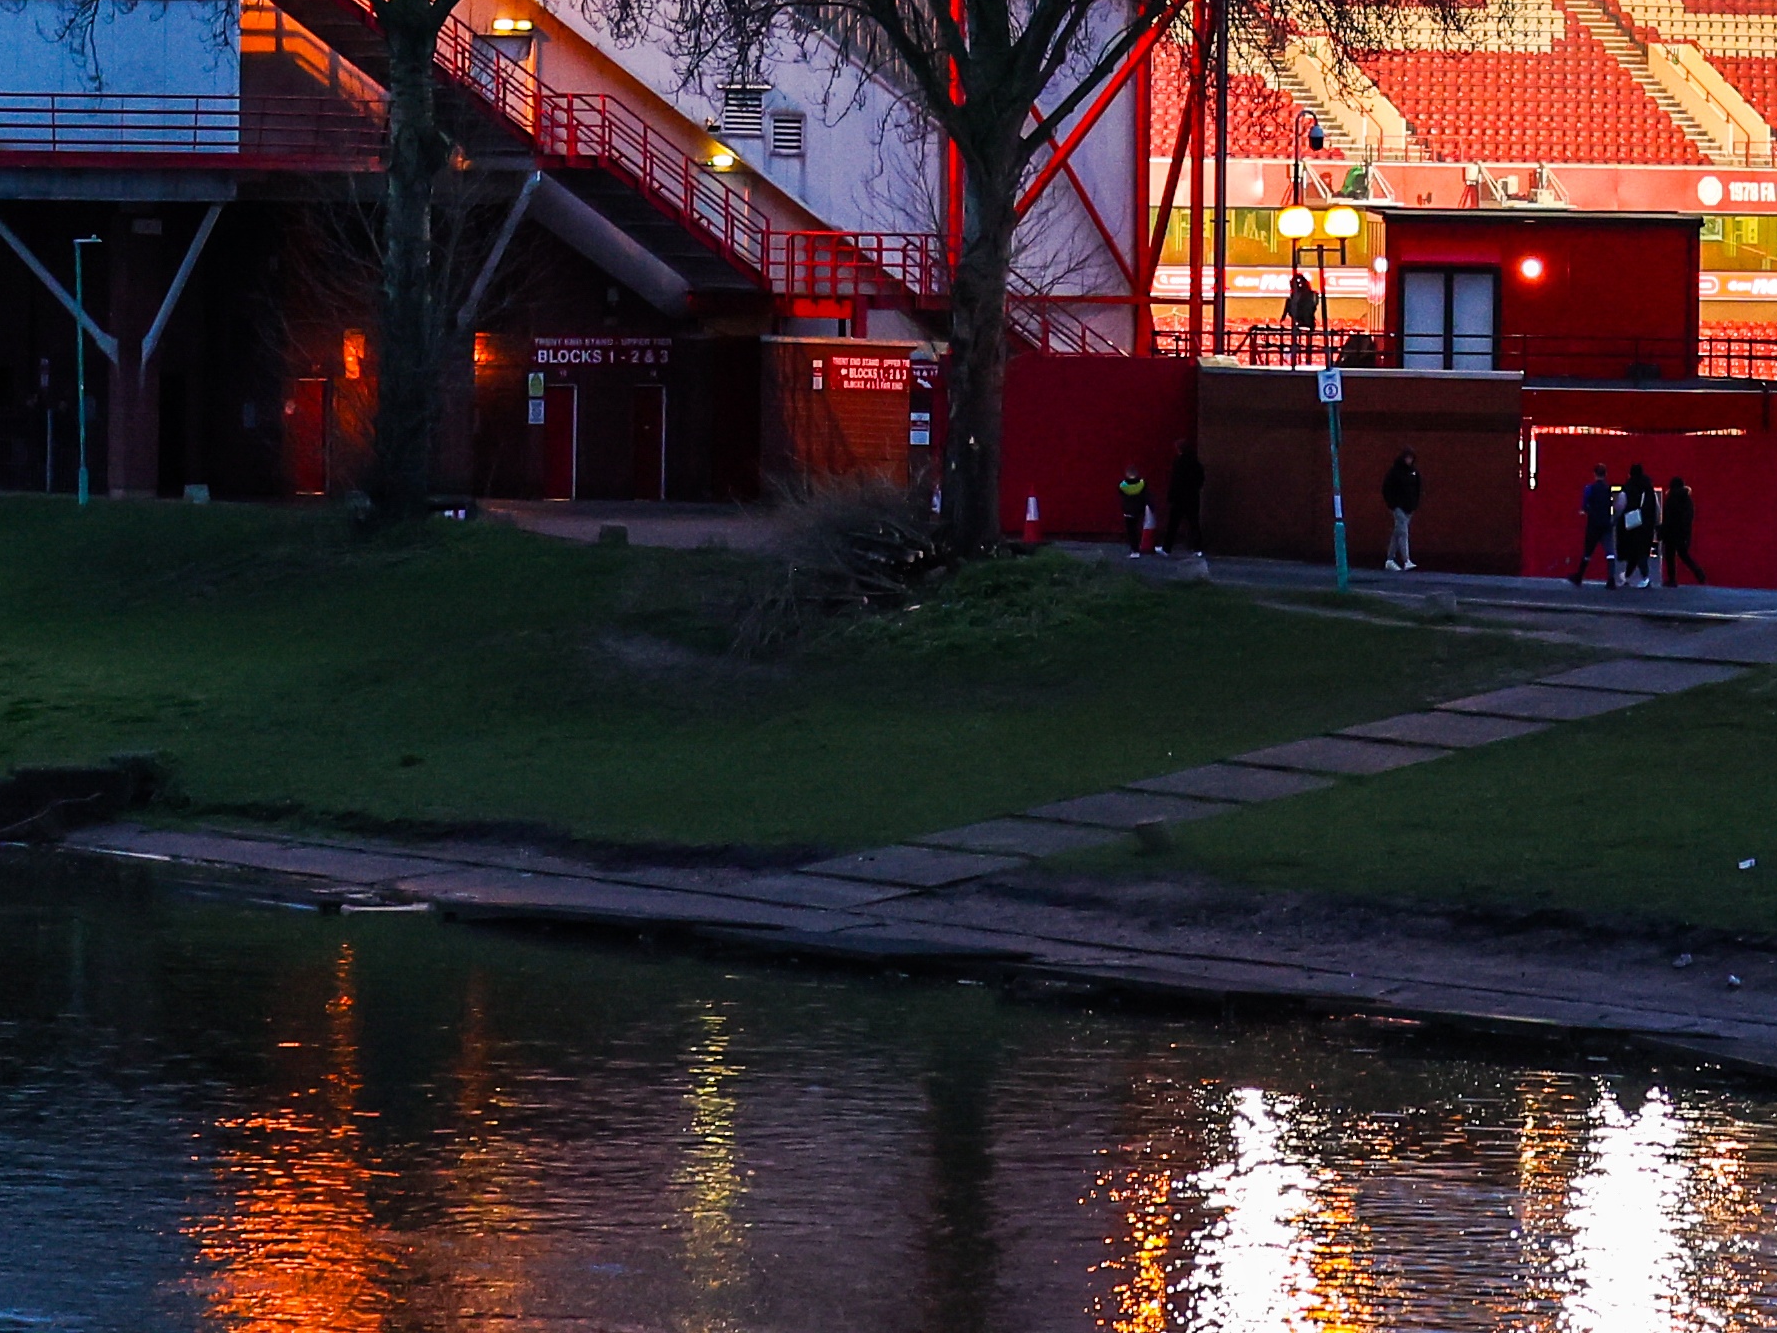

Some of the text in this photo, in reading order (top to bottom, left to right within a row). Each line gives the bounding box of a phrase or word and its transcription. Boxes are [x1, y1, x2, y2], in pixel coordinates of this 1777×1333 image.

[1760, 182, 1777, 202] FA
[537, 349, 603, 364] BLOCKS
[609, 351, 615, 364] 1
[630, 350, 640, 364] 2
[644, 350, 655, 364] &
[659, 350, 669, 364] 3
[849, 367, 878, 379] BLOCKS
[889, 369, 894, 380] 2
[902, 369, 907, 380] 3
